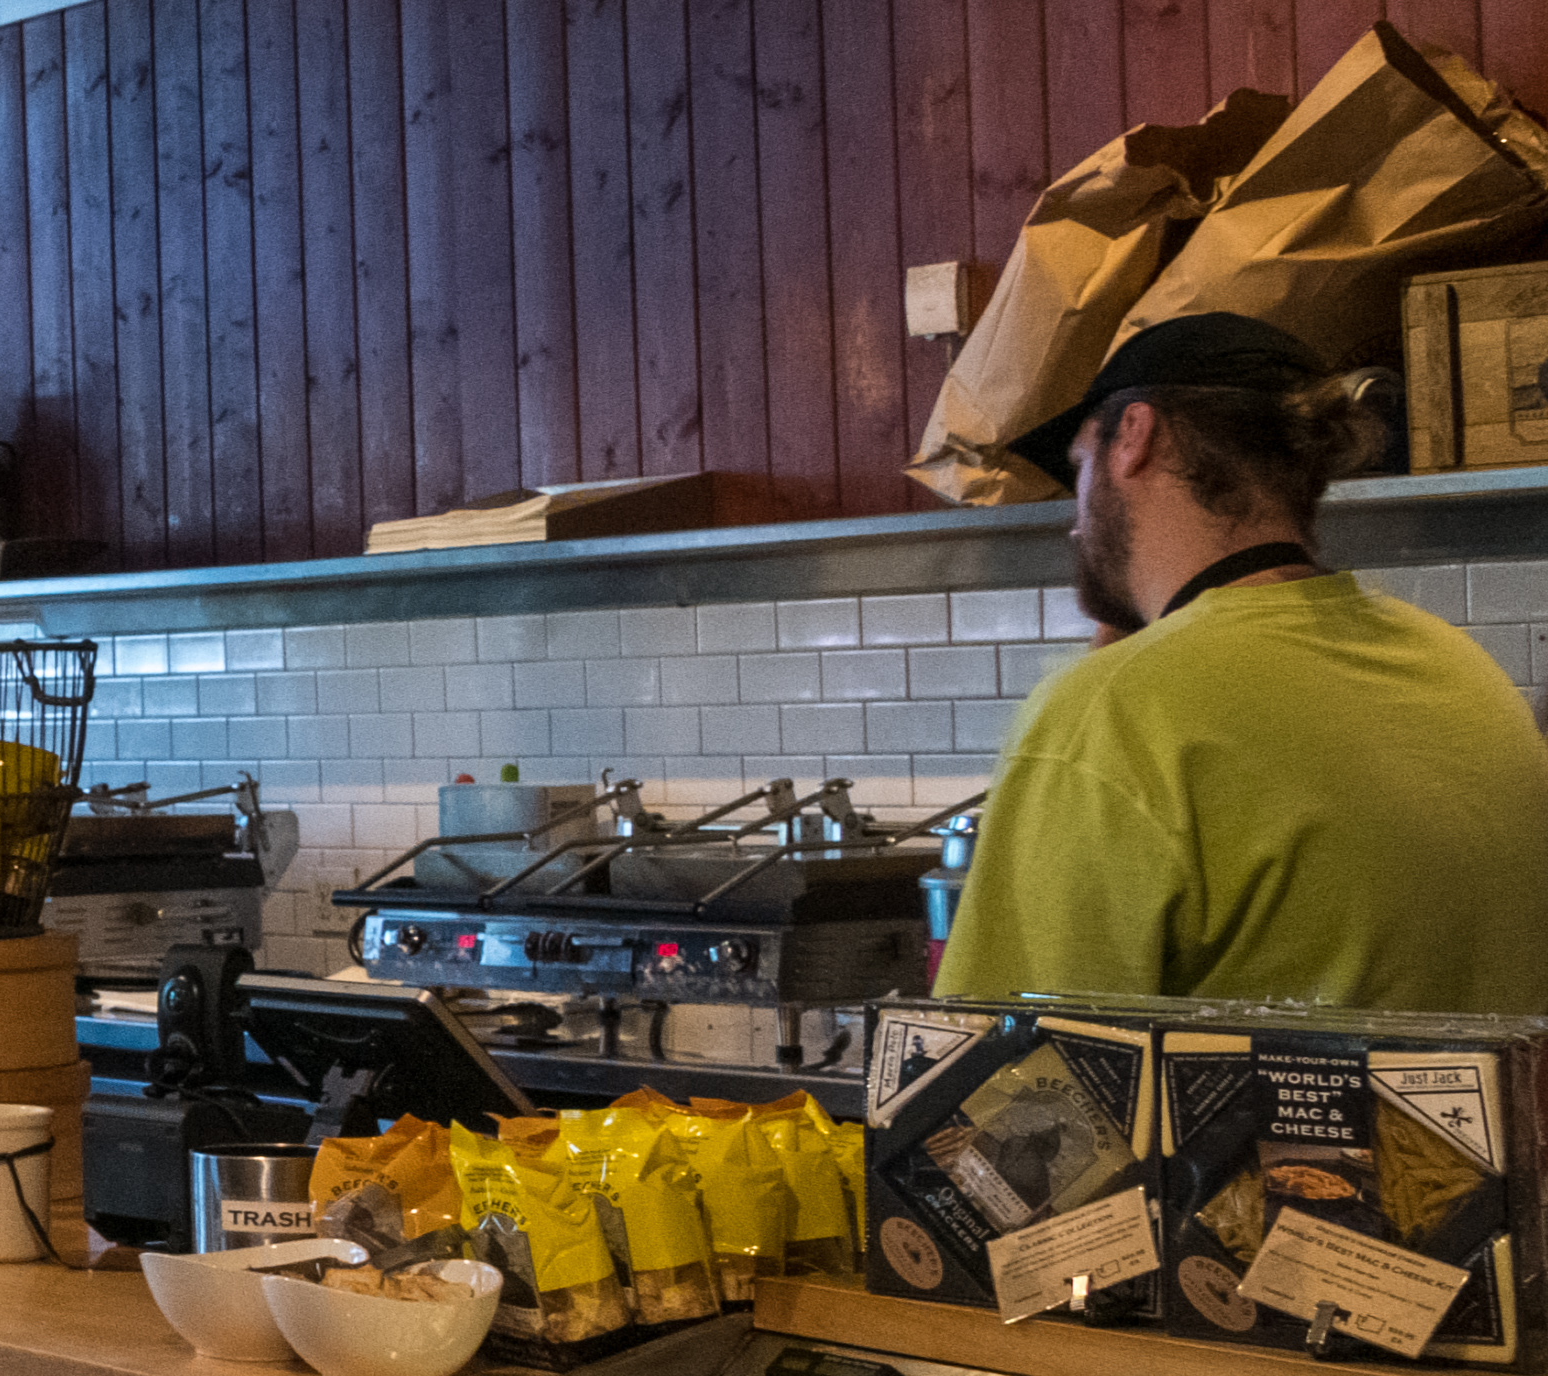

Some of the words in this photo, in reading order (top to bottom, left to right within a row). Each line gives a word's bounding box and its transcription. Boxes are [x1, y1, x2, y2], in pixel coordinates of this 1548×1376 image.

[888, 1028, 900, 1053] Polo
[1258, 1054, 1360, 1067] MAKE-YOUR-OWN
[884, 1055, 896, 1090] Marco
[1399, 1072, 1427, 1086] Just
[1432, 1070, 1462, 1084] Jack
[1035, 1076, 1113, 1152] BEECHER'S
[1278, 1105, 1323, 1120] MAC
[1328, 1109, 1343, 1122] &
[1270, 1122, 1355, 1140] CHEESE
[228, 1209, 312, 1228] TRASH
[940, 1186, 990, 1239] Original
[1276, 1224, 1325, 1249] WORLD'S
[1326, 1240, 1355, 1257] BEST
